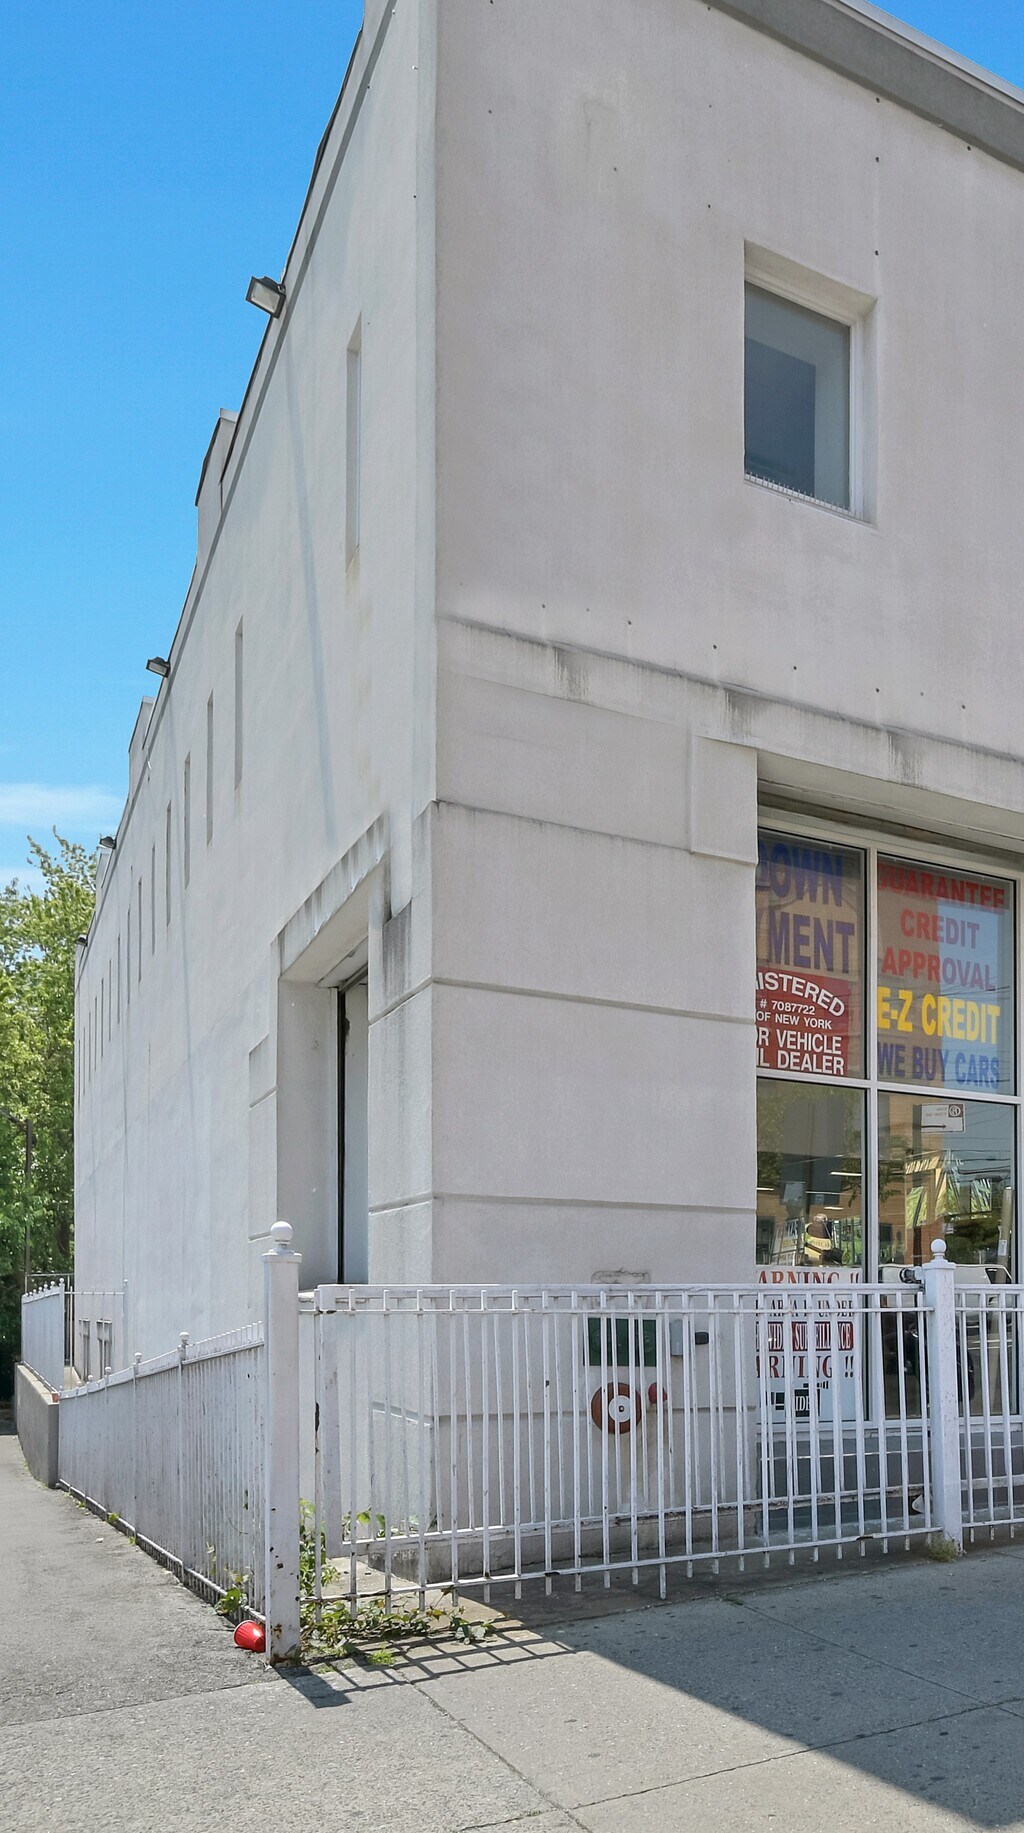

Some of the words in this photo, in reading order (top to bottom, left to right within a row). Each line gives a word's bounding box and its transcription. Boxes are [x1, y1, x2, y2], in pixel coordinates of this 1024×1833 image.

[877, 863, 1005, 914] GUARANTEE
[901, 908, 980, 949] CREDIT
[881, 946, 995, 991] APPROVAL
[771, 1000, 816, 1016] 7087722
[775, 1013, 800, 1026] NEW
[804, 1017, 833, 1031] YORK
[877, 986, 913, 1033] E-Z
[921, 993, 1001, 1044] CREDIT
[776, 1028, 842, 1056] VEHICLE
[777, 1049, 844, 1076] DEALER
[877, 1040, 906, 1078] WE
[912, 1045, 949, 1083] BUY
[955, 1051, 1000, 1090] CARS
